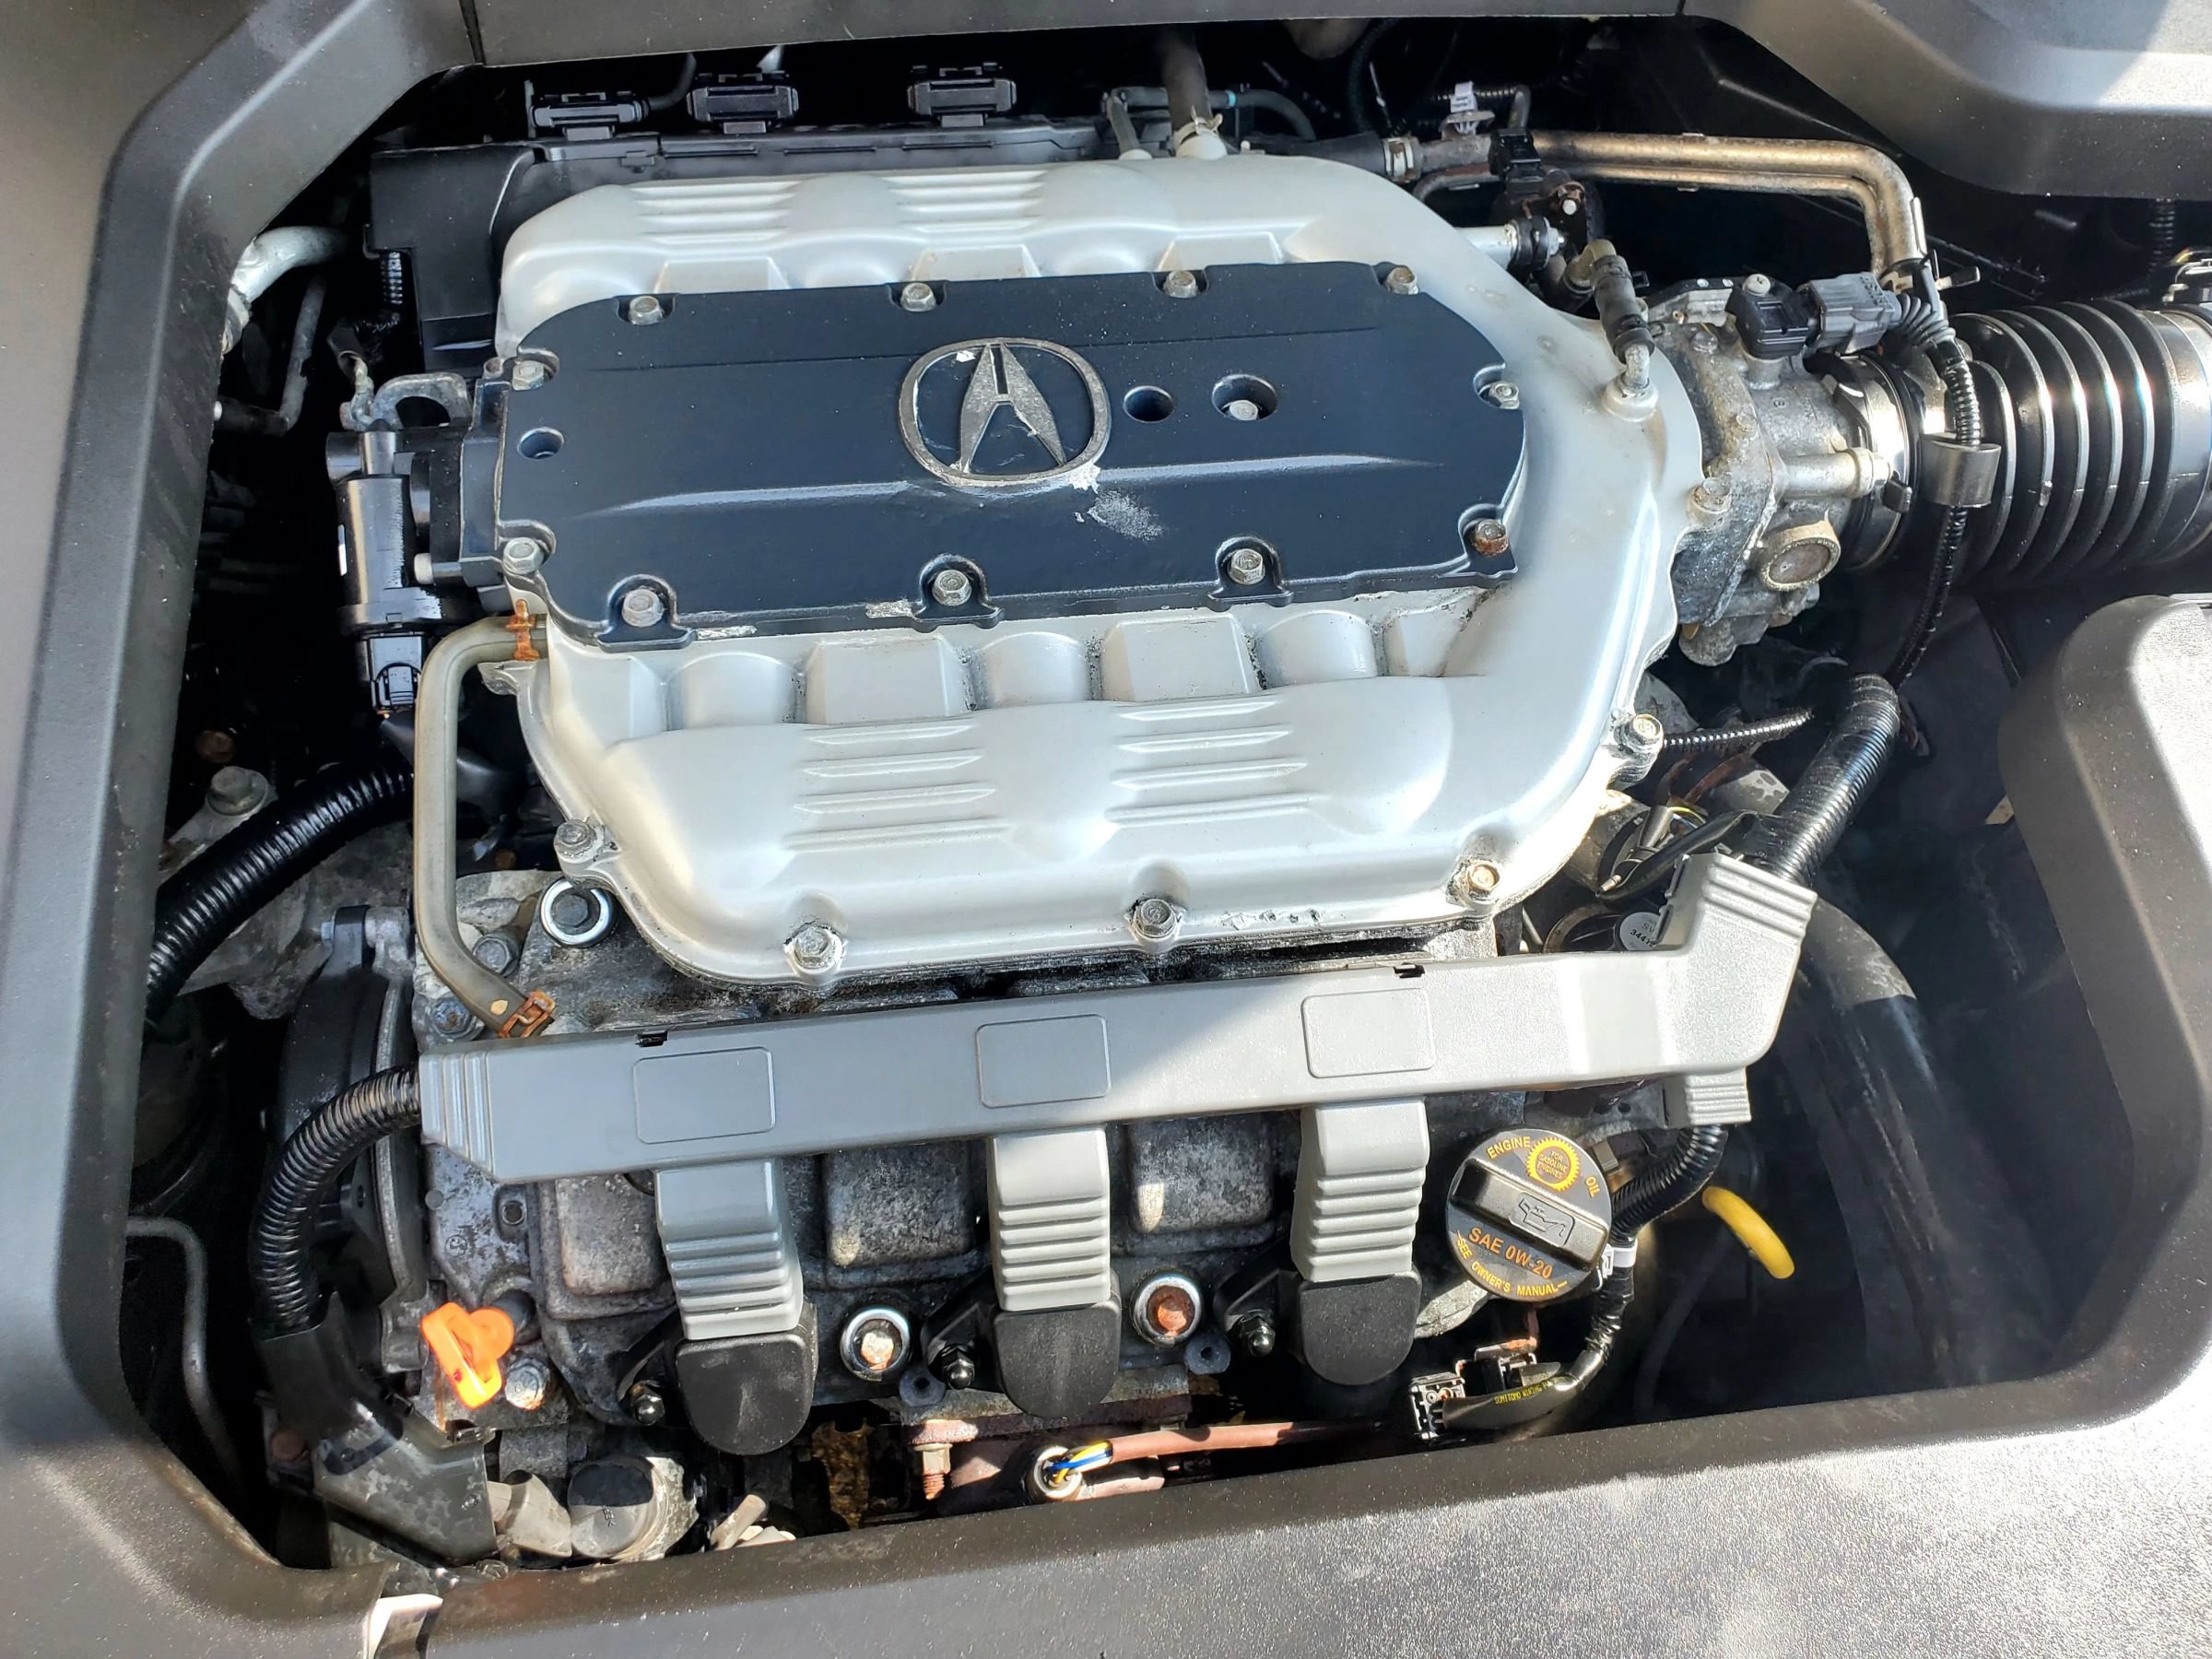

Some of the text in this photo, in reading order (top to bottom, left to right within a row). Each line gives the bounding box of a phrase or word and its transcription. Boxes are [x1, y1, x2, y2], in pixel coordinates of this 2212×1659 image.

[1538, 1154, 1569, 1173] GASOLINE
[1550, 1150, 1564, 1162] FOR
[1487, 1135, 1600, 1198] ENGINE OIL
[1536, 1160, 1564, 1180] ENGINES
[1468, 1226, 1554, 1280] SAE 0W-20
[1471, 1261, 1512, 1293] OWNER'S
[1522, 1384, 1543, 1398] WIRING
